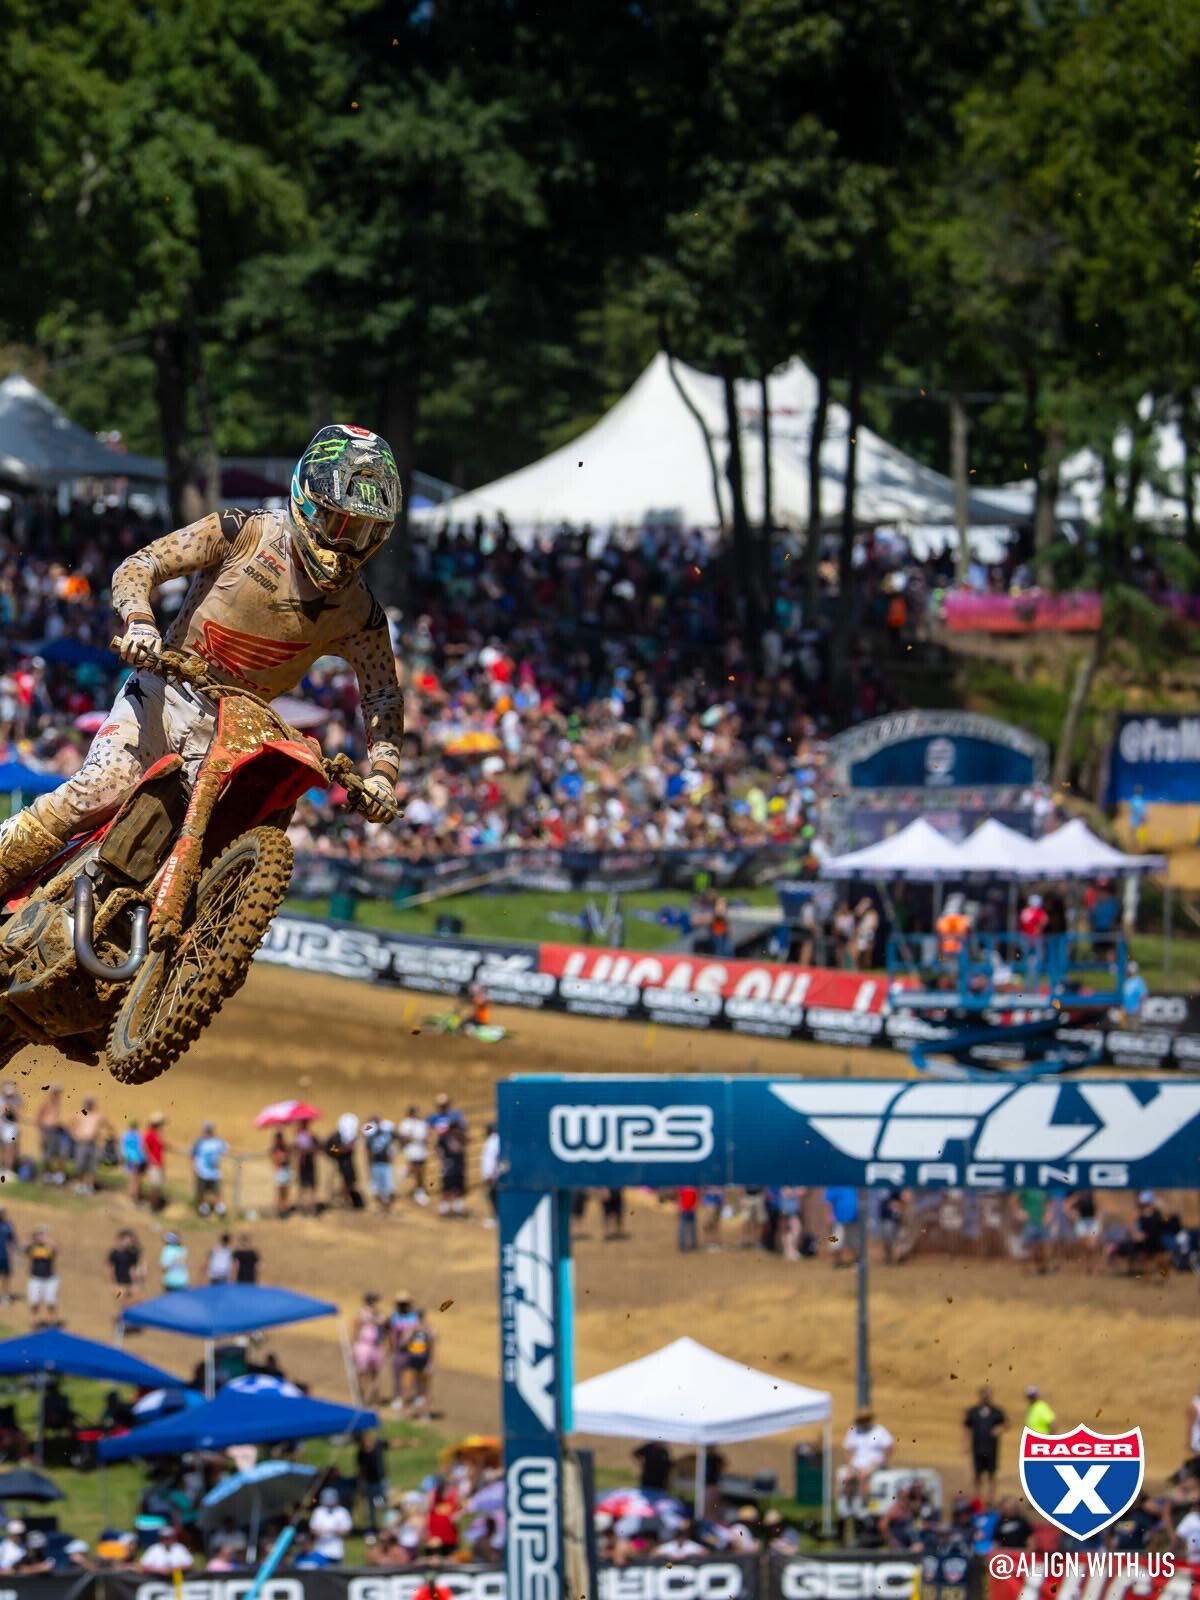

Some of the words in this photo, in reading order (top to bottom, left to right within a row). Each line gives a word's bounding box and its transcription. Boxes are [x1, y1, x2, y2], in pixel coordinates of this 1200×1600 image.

[243, 565, 279, 594] SHOWA
[156, 856, 178, 906] DUNLOP
[562, 951, 728, 1000] LUCAS
[549, 1104, 714, 1163] WPS
[767, 1082, 1200, 1162] FLY
[865, 1163, 1130, 1187] RACING
